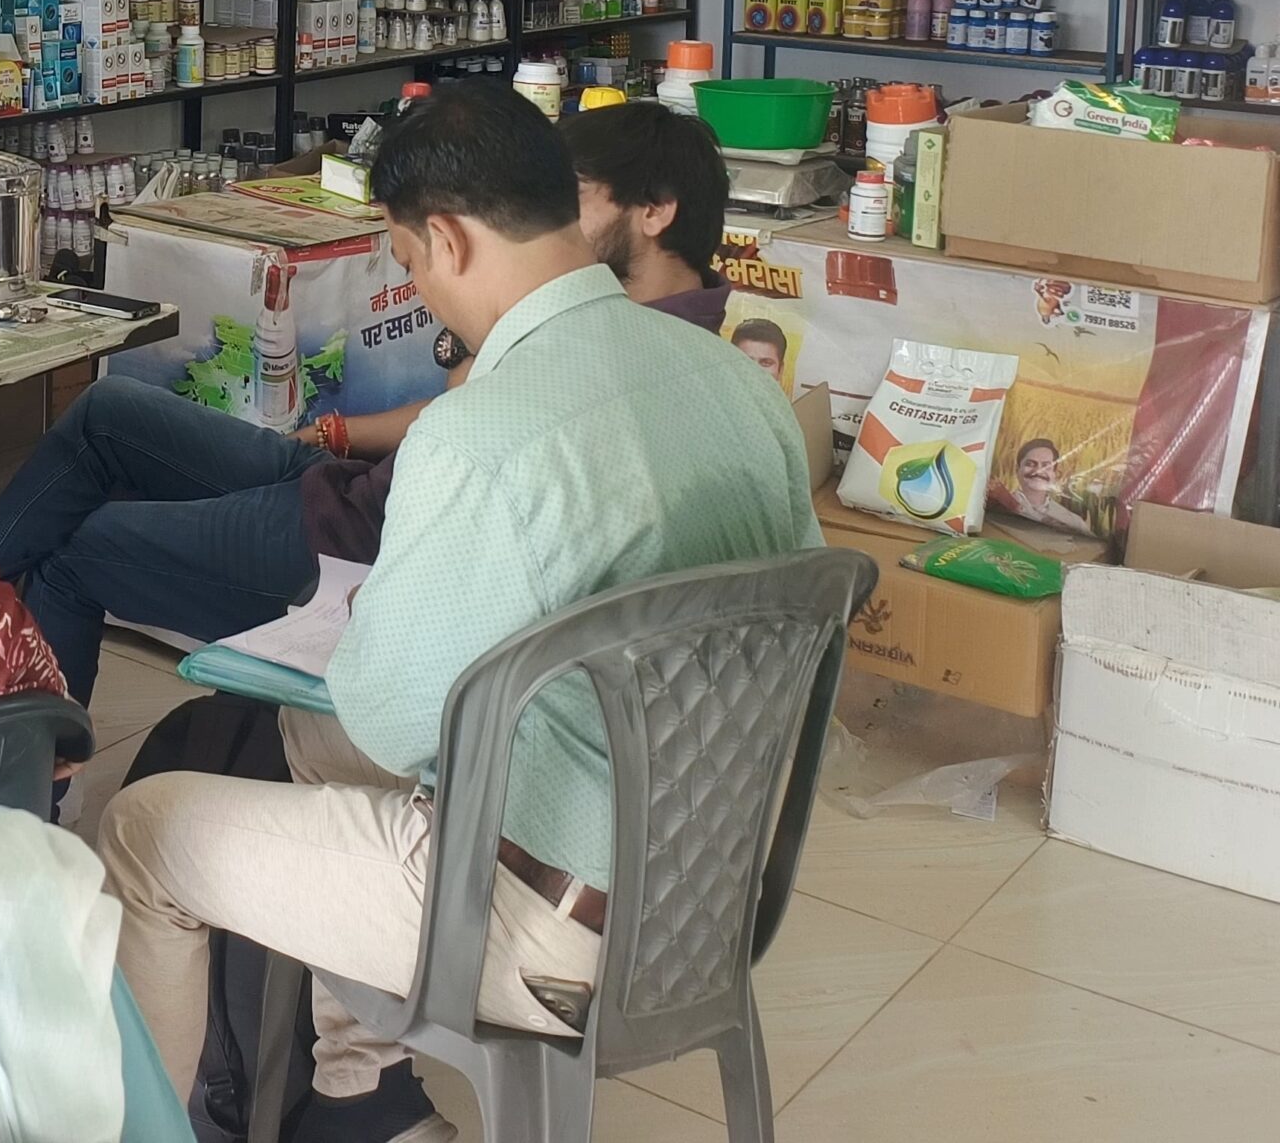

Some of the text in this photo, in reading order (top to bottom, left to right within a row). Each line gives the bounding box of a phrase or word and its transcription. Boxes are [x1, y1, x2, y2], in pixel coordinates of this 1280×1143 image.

[1087, 111, 1119, 124] Green
[1122, 116, 1148, 131] India
[725, 258, 803, 298] भरोसा
[370, 284, 389, 312] नई
[361, 312, 413, 349] पर सब
[888, 401, 978, 425] CERTASTAR GR
